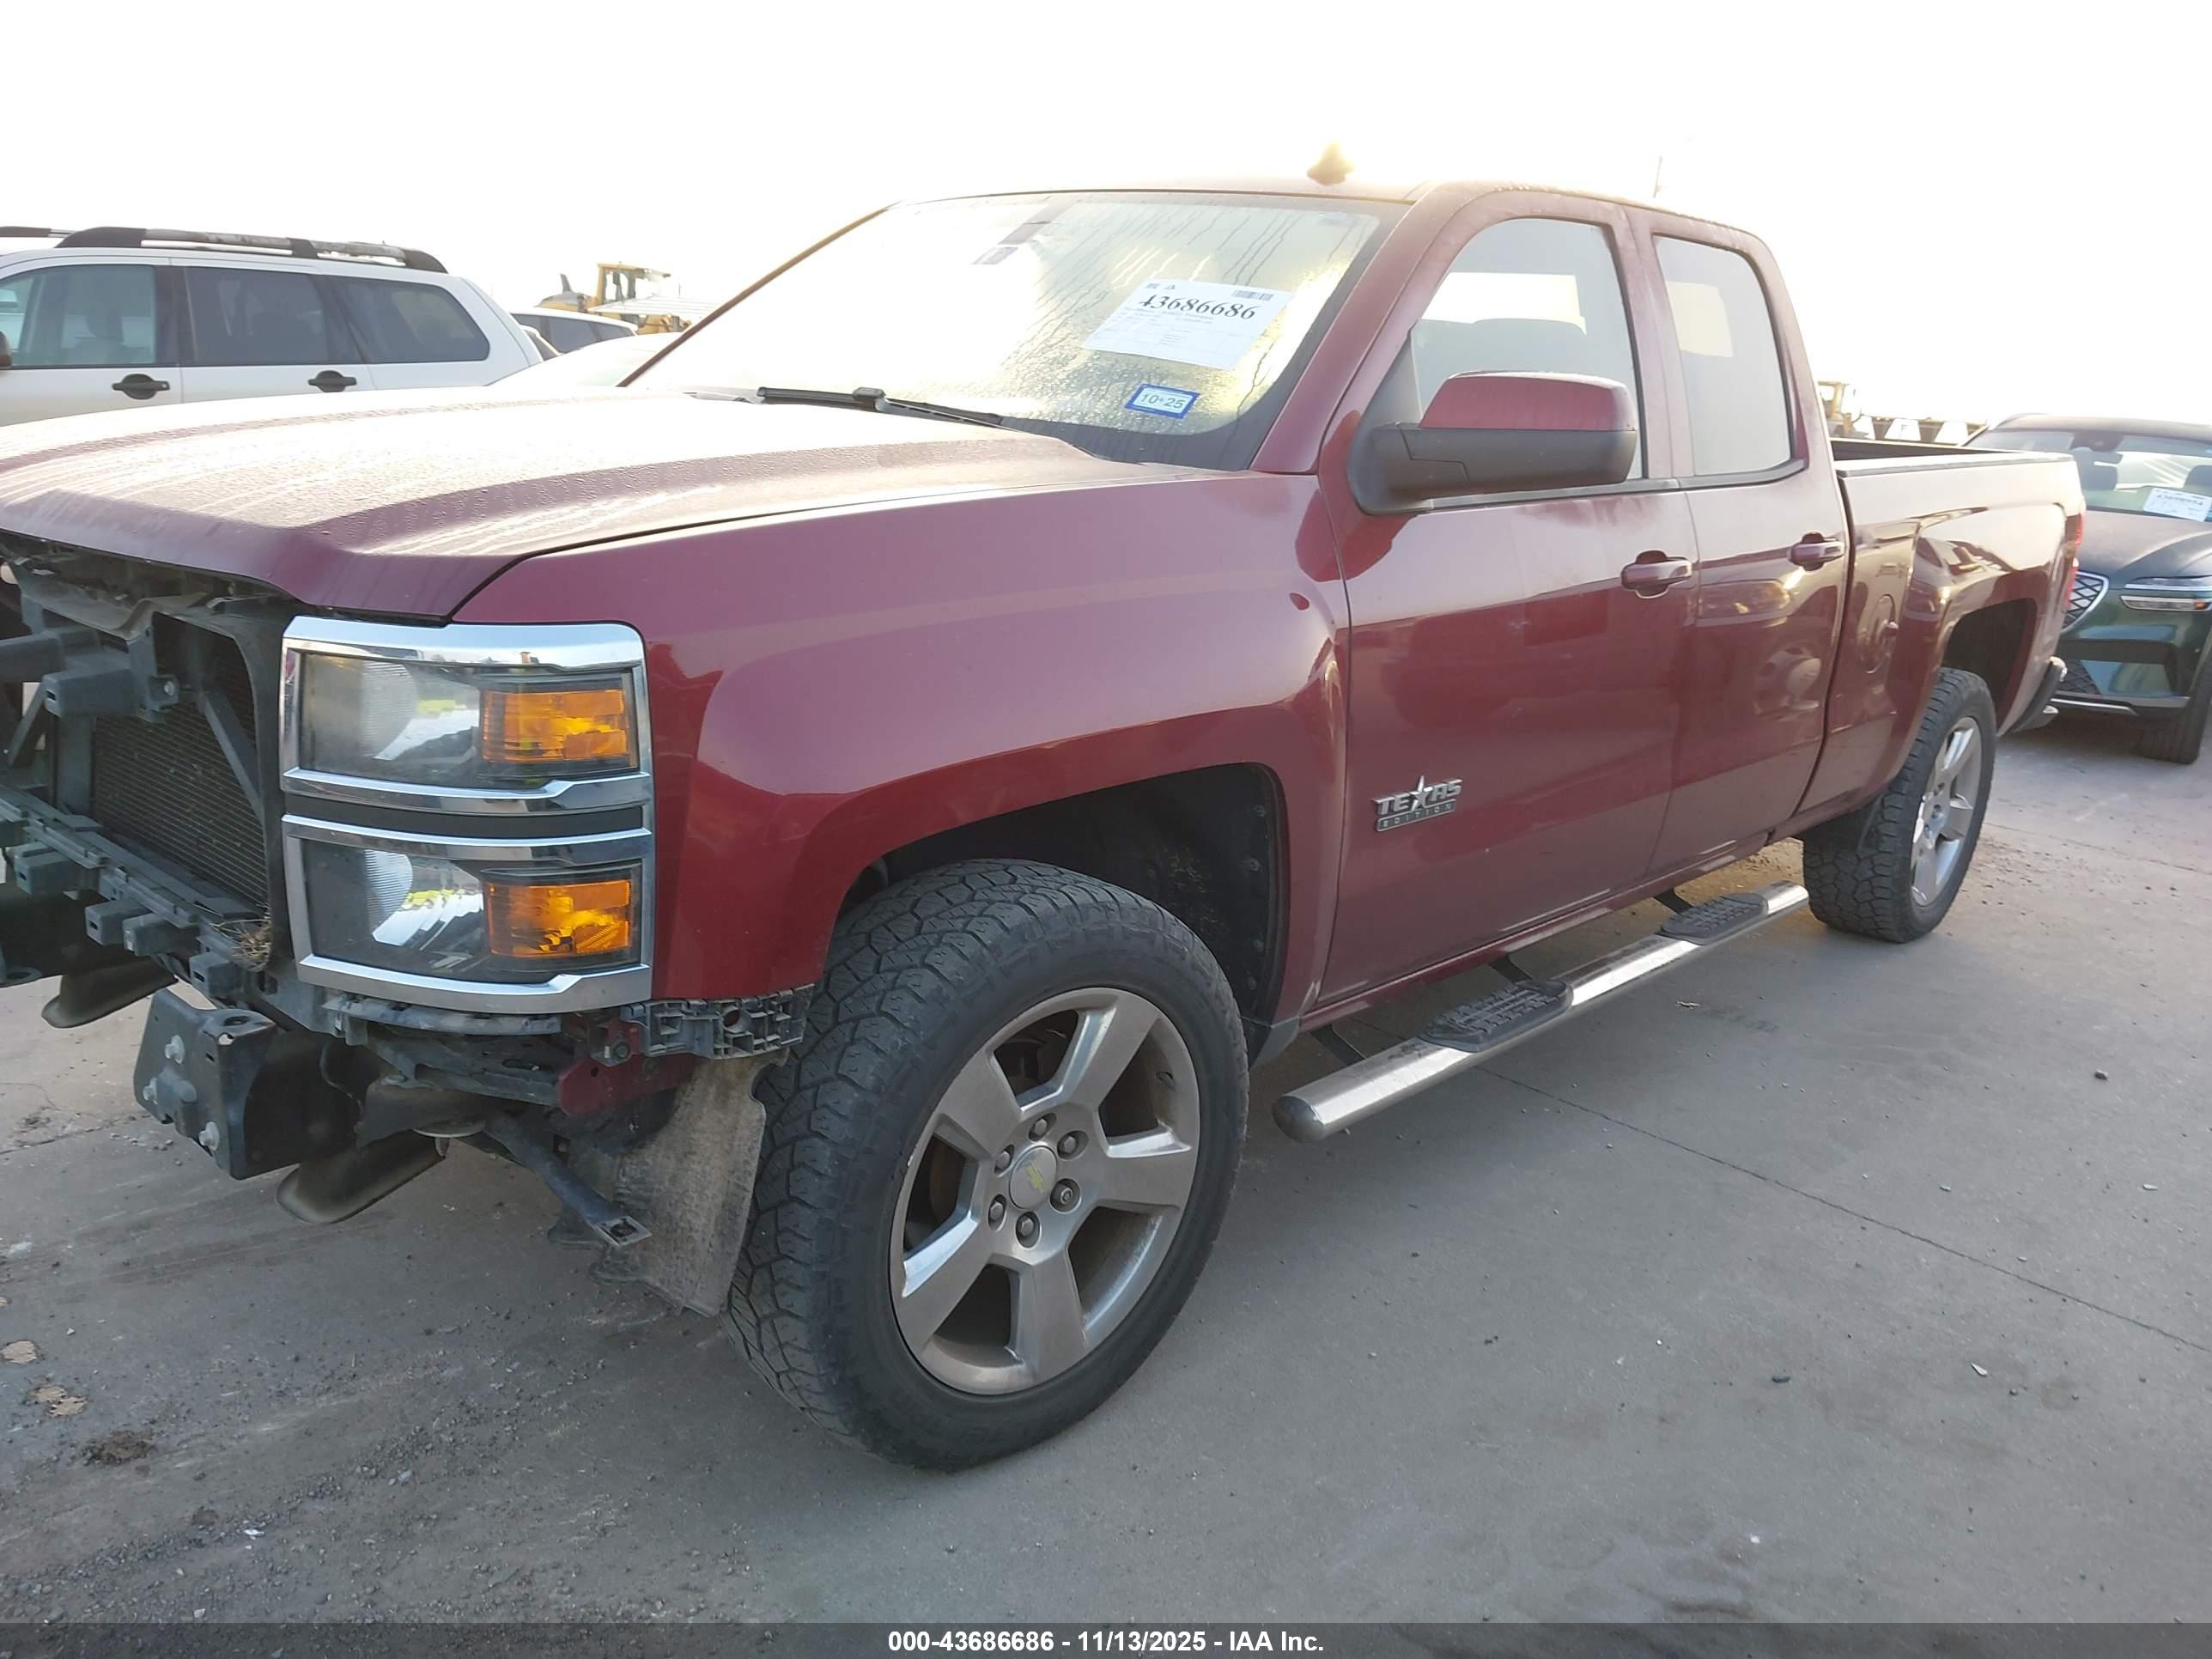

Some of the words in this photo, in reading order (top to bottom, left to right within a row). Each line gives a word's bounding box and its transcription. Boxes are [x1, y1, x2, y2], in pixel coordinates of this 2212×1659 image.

[1139, 295, 1262, 319] 43686686
[1371, 775, 1463, 816] TEXAS
[1382, 803, 1453, 828] EDITION
